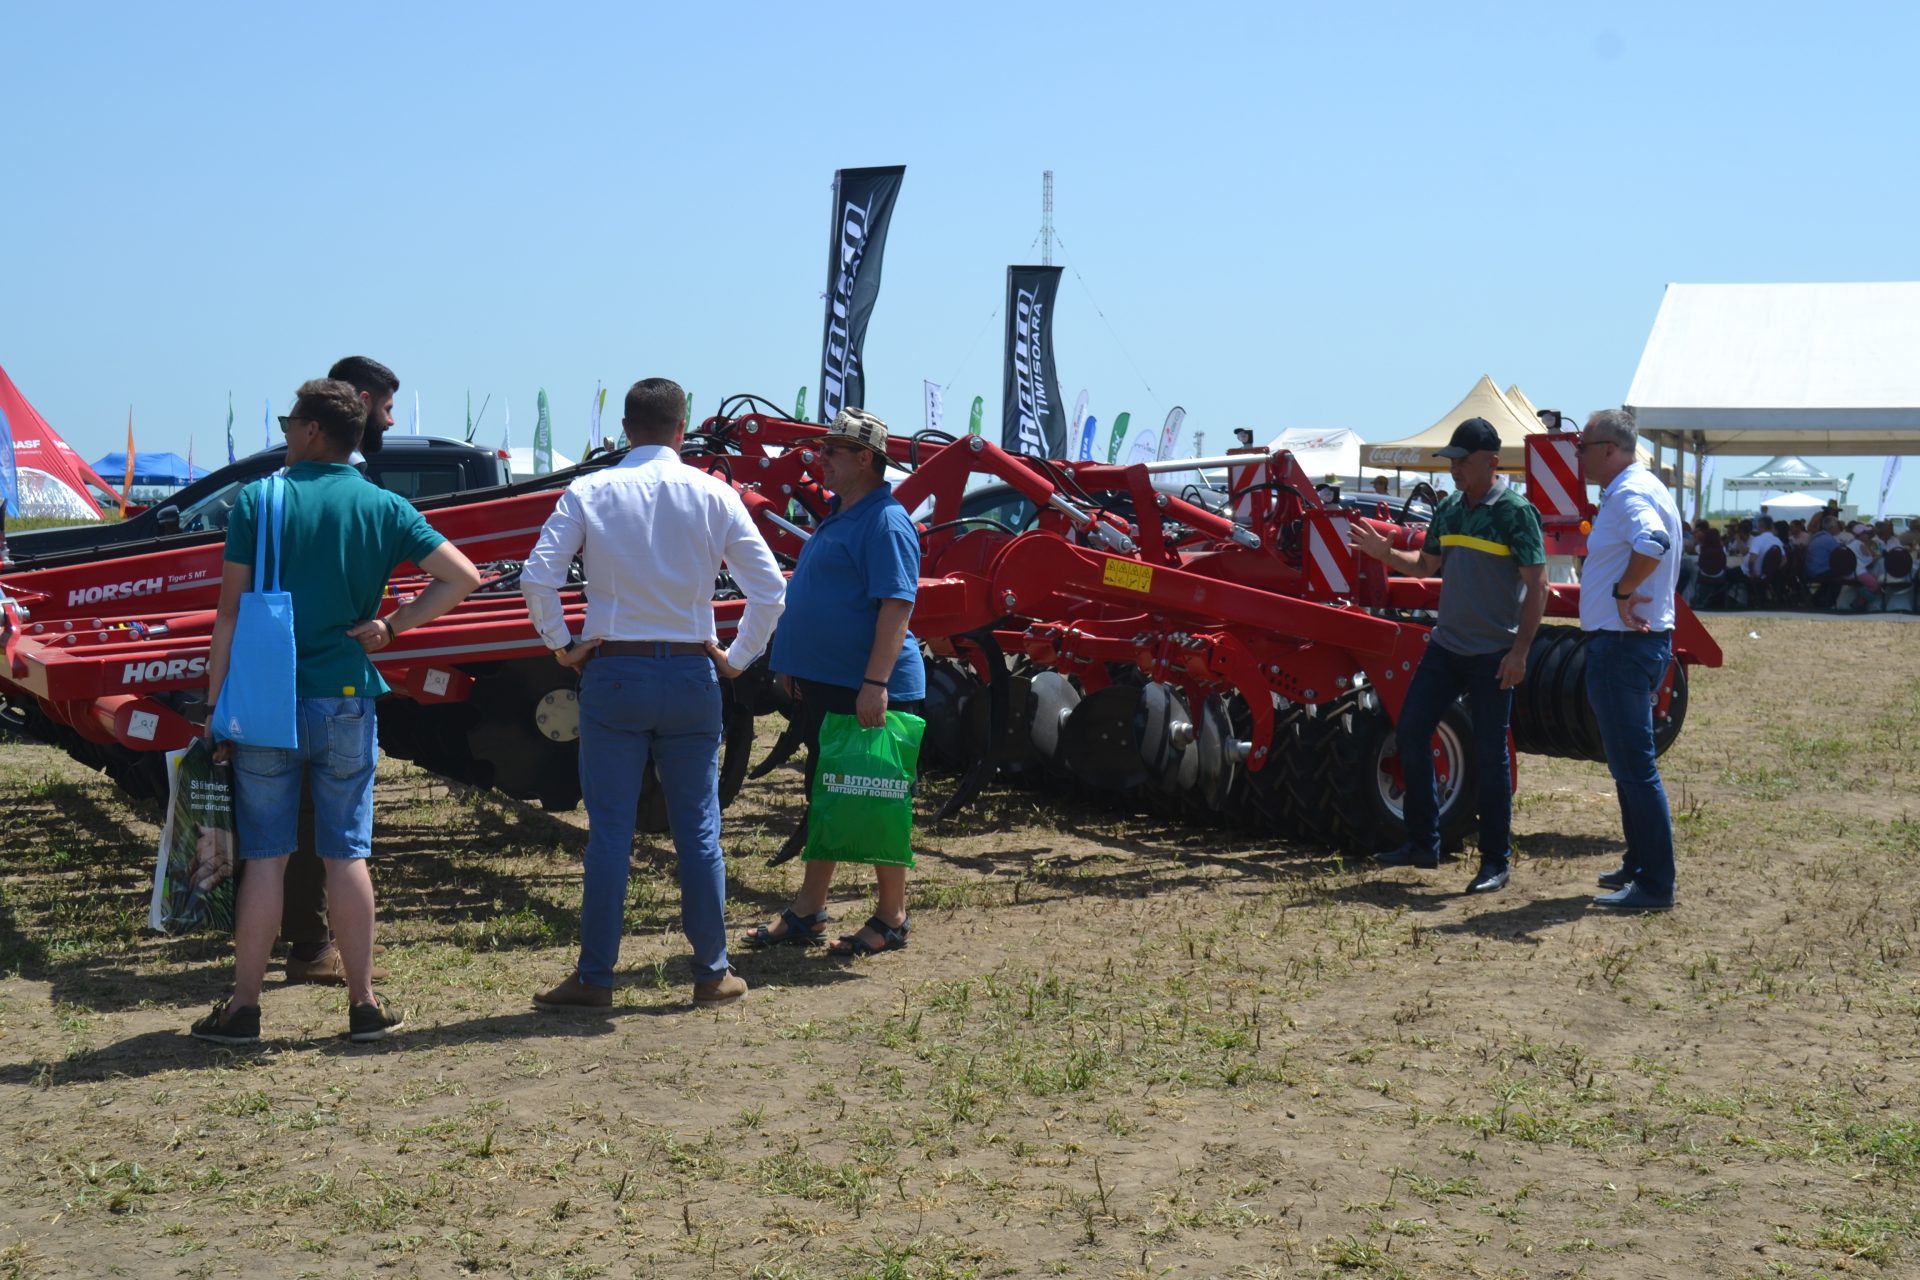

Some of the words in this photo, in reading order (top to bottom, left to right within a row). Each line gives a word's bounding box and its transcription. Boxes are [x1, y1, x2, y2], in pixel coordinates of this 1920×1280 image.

[1031, 303, 1049, 416] TIMISOARA
[168, 574, 186, 583] Tiger
[194, 570, 206, 579] MT
[68, 577, 163, 608] HORSCH
[122, 657, 210, 684] HORS
[869, 789, 905, 799] ROMANIA
